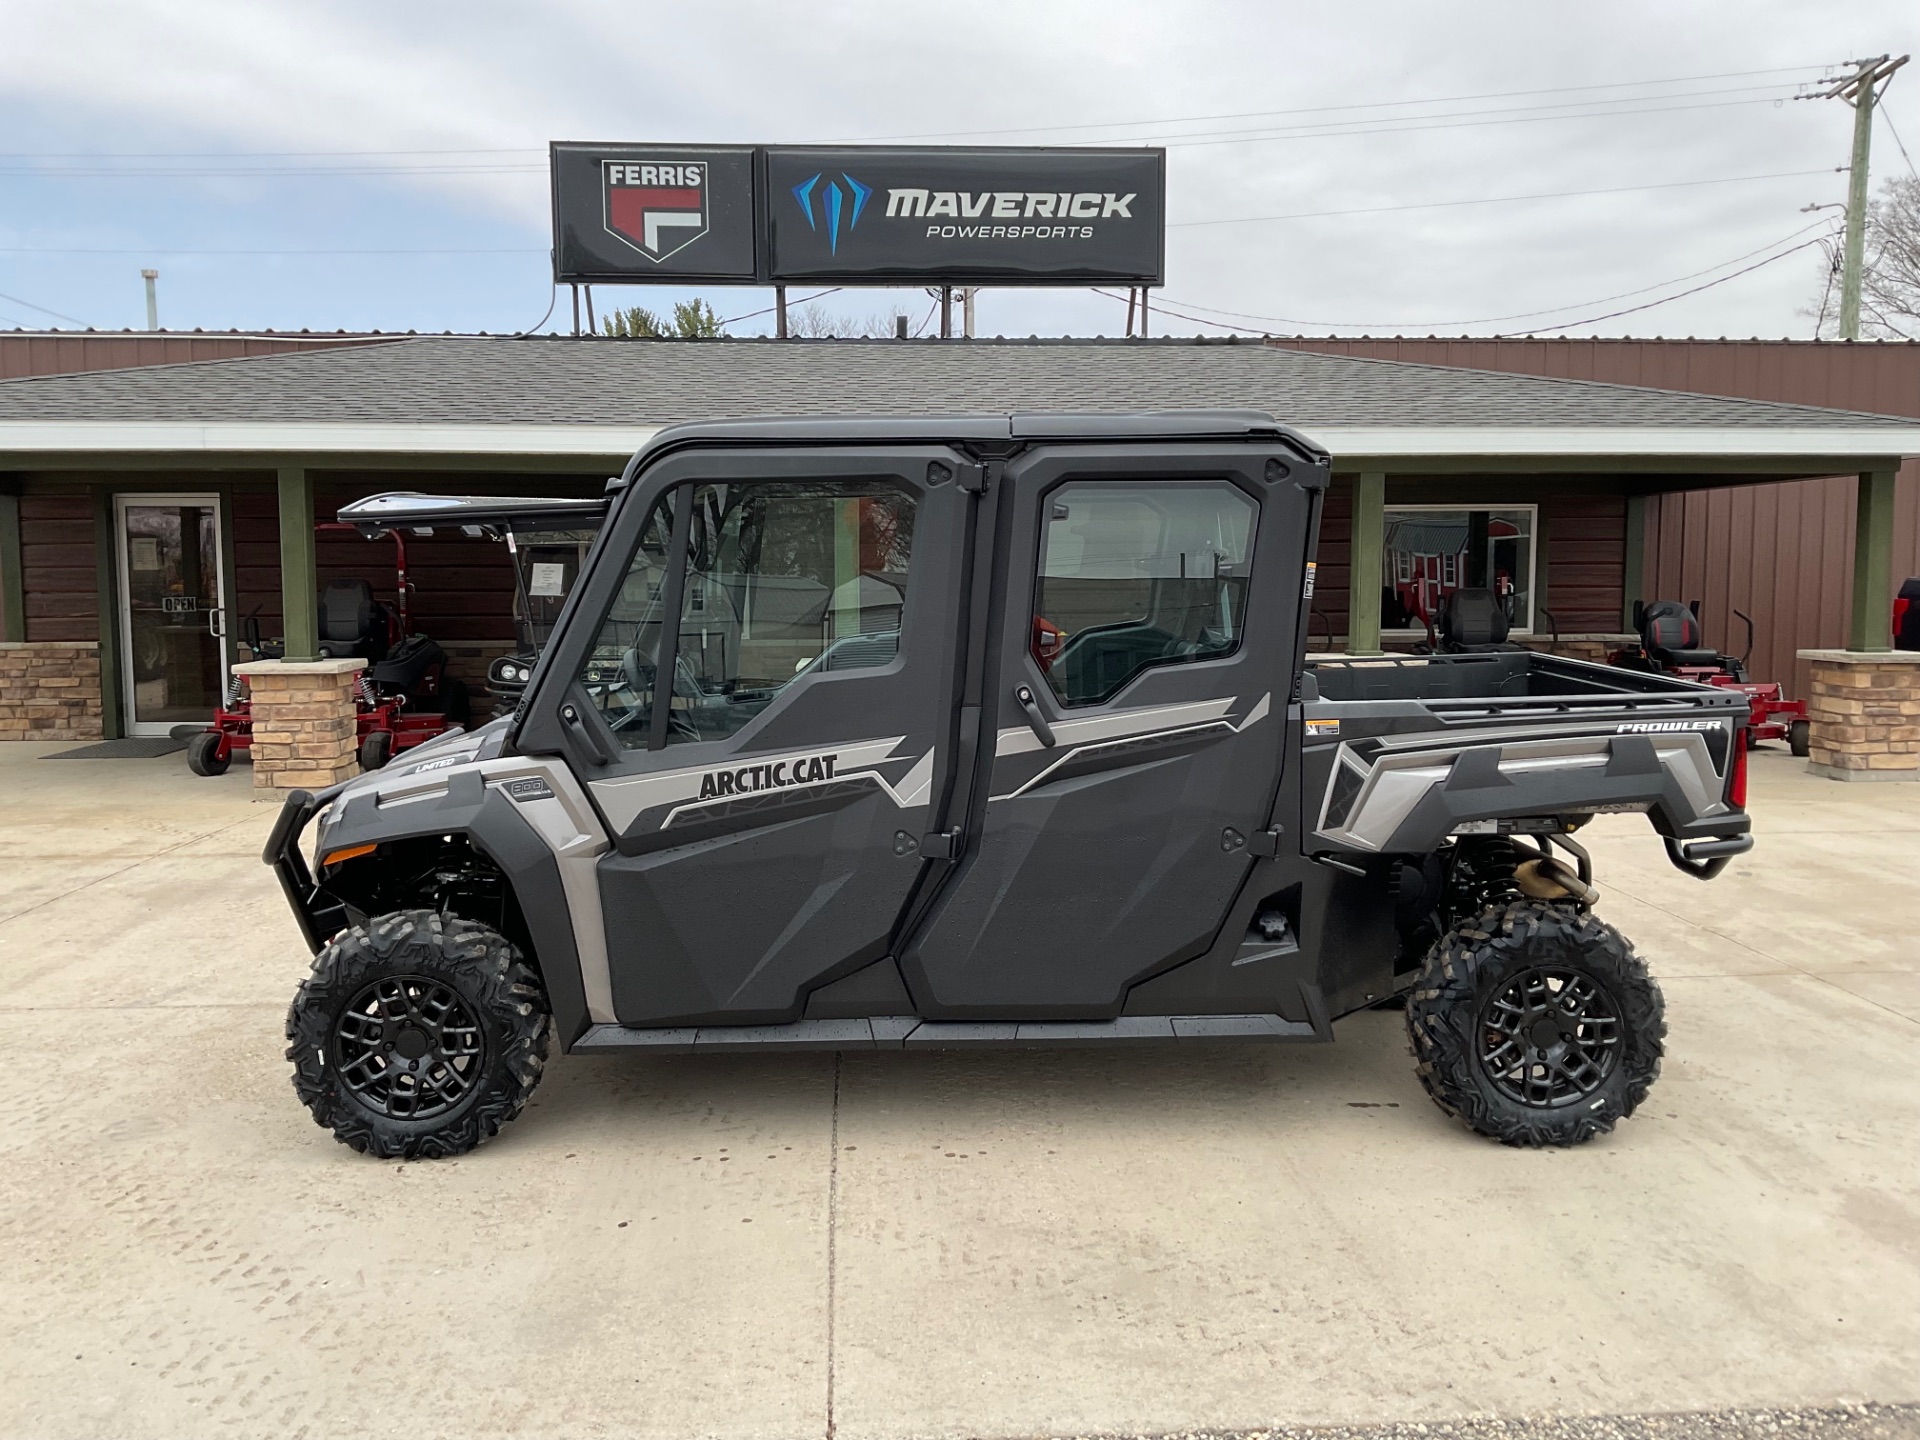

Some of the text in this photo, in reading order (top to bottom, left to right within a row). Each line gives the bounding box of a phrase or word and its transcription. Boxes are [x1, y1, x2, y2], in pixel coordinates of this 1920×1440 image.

[609, 165, 701, 187] FERRIS
[885, 188, 1138, 218] MAVERICK
[926, 225, 1094, 238] POWERSPORTS
[165, 597, 195, 611] OPEN
[1616, 720, 1722, 733] PROWLER
[415, 757, 455, 773] LIMITED
[698, 754, 838, 800] ARCTIC CAT
